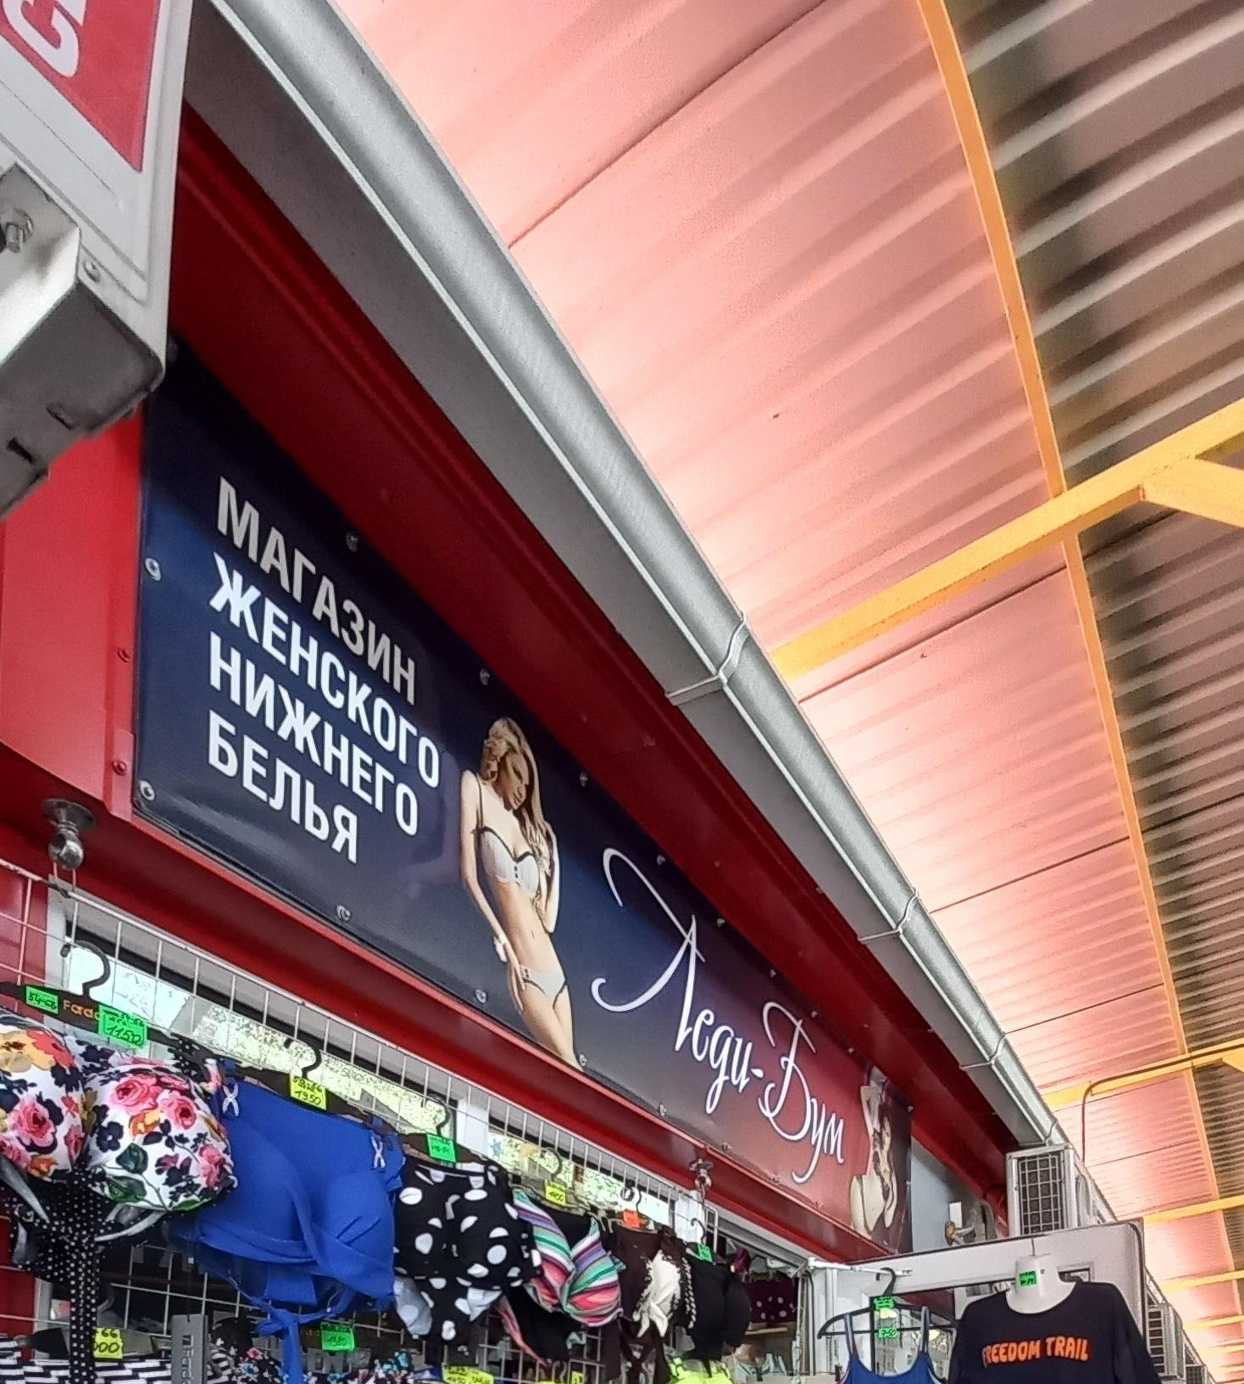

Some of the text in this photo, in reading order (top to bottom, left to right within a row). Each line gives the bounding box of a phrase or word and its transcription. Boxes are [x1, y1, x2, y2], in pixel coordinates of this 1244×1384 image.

[209, 552, 440, 789] ЖЕНСКОГО
[217, 476, 415, 705] МАГАЗИН
[208, 709, 357, 864] БЕЛЬЯ
[210, 631, 418, 836] НИЖНЕГО
[591, 847, 845, 1184] Леди-Бум
[982, 1336, 1089, 1368] FREEDOM TRAIL
